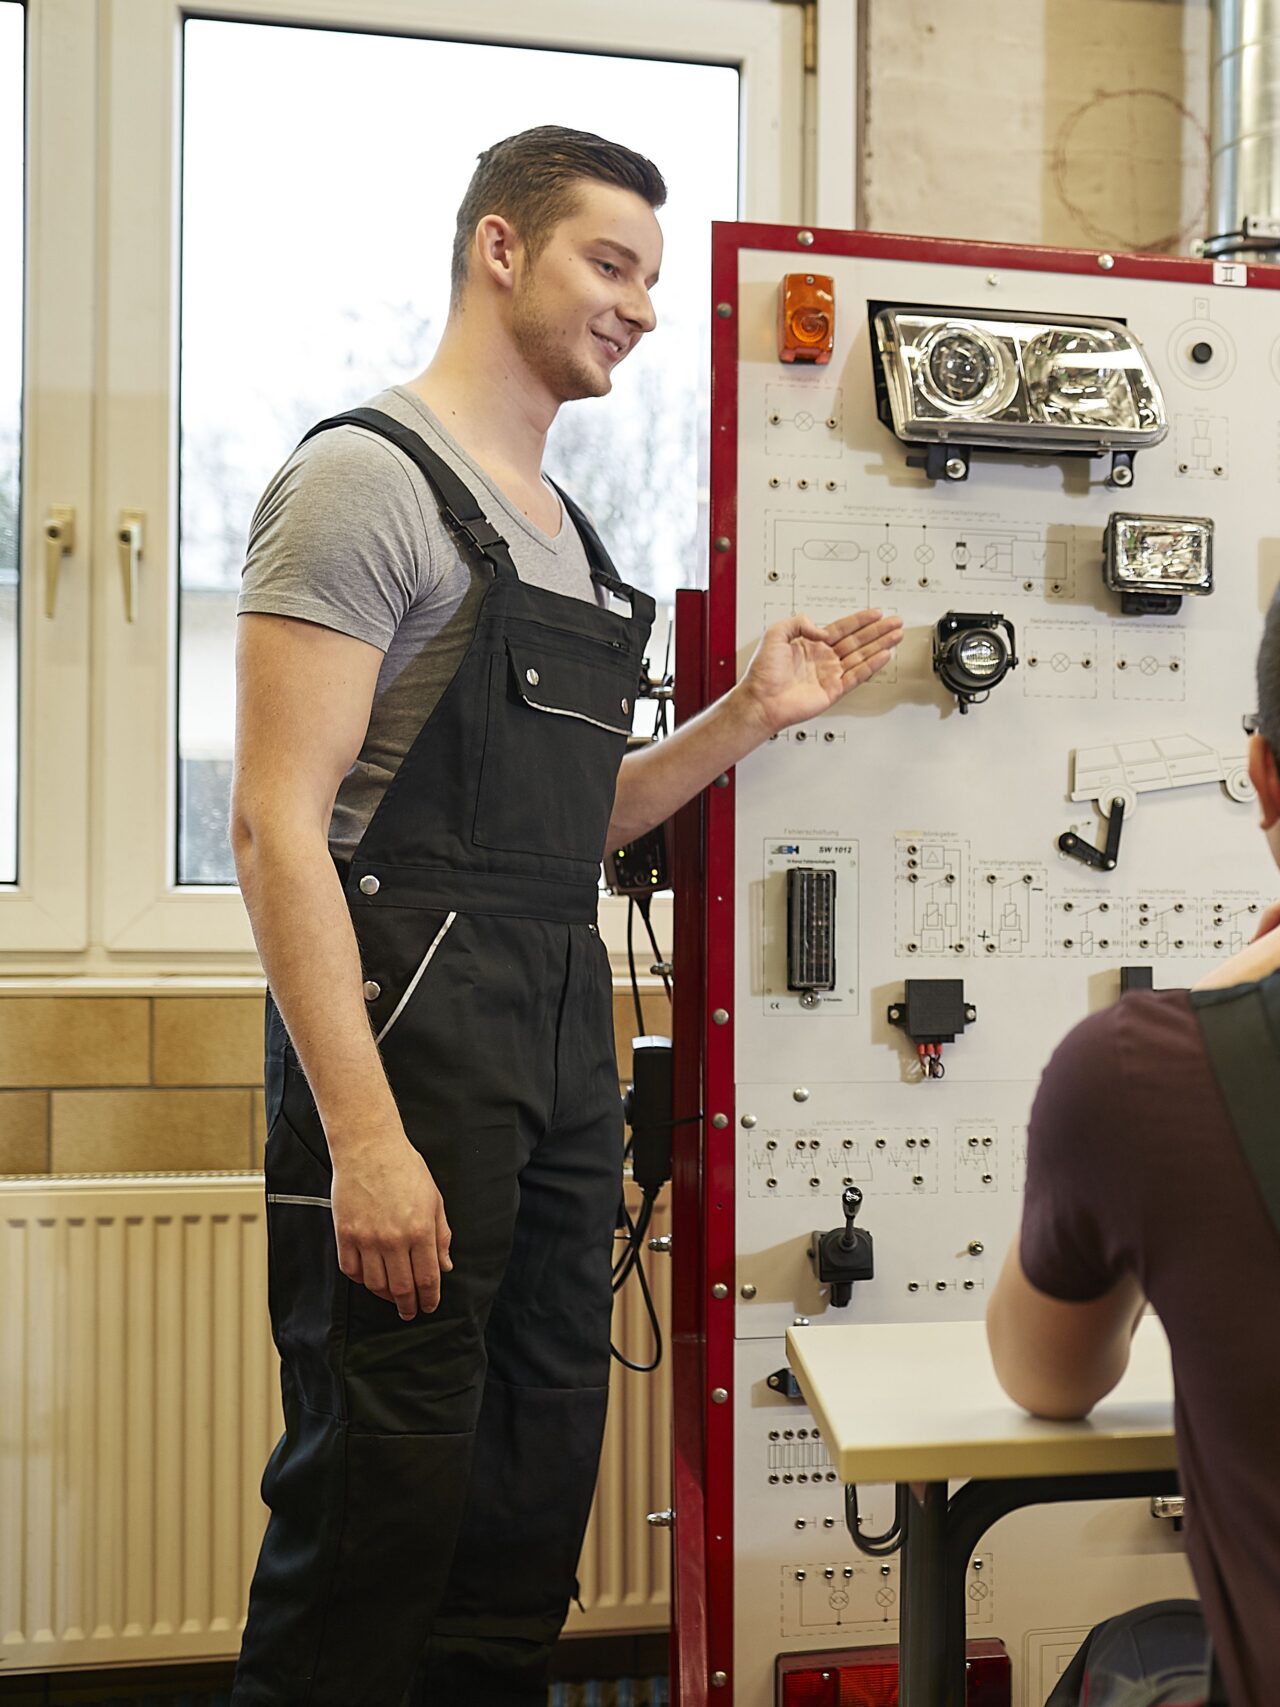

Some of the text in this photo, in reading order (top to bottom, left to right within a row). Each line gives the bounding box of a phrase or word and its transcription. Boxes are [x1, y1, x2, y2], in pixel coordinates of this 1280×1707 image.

[1221, 266, 1237, 283] II
[818, 846, 853, 854] SW 1012
